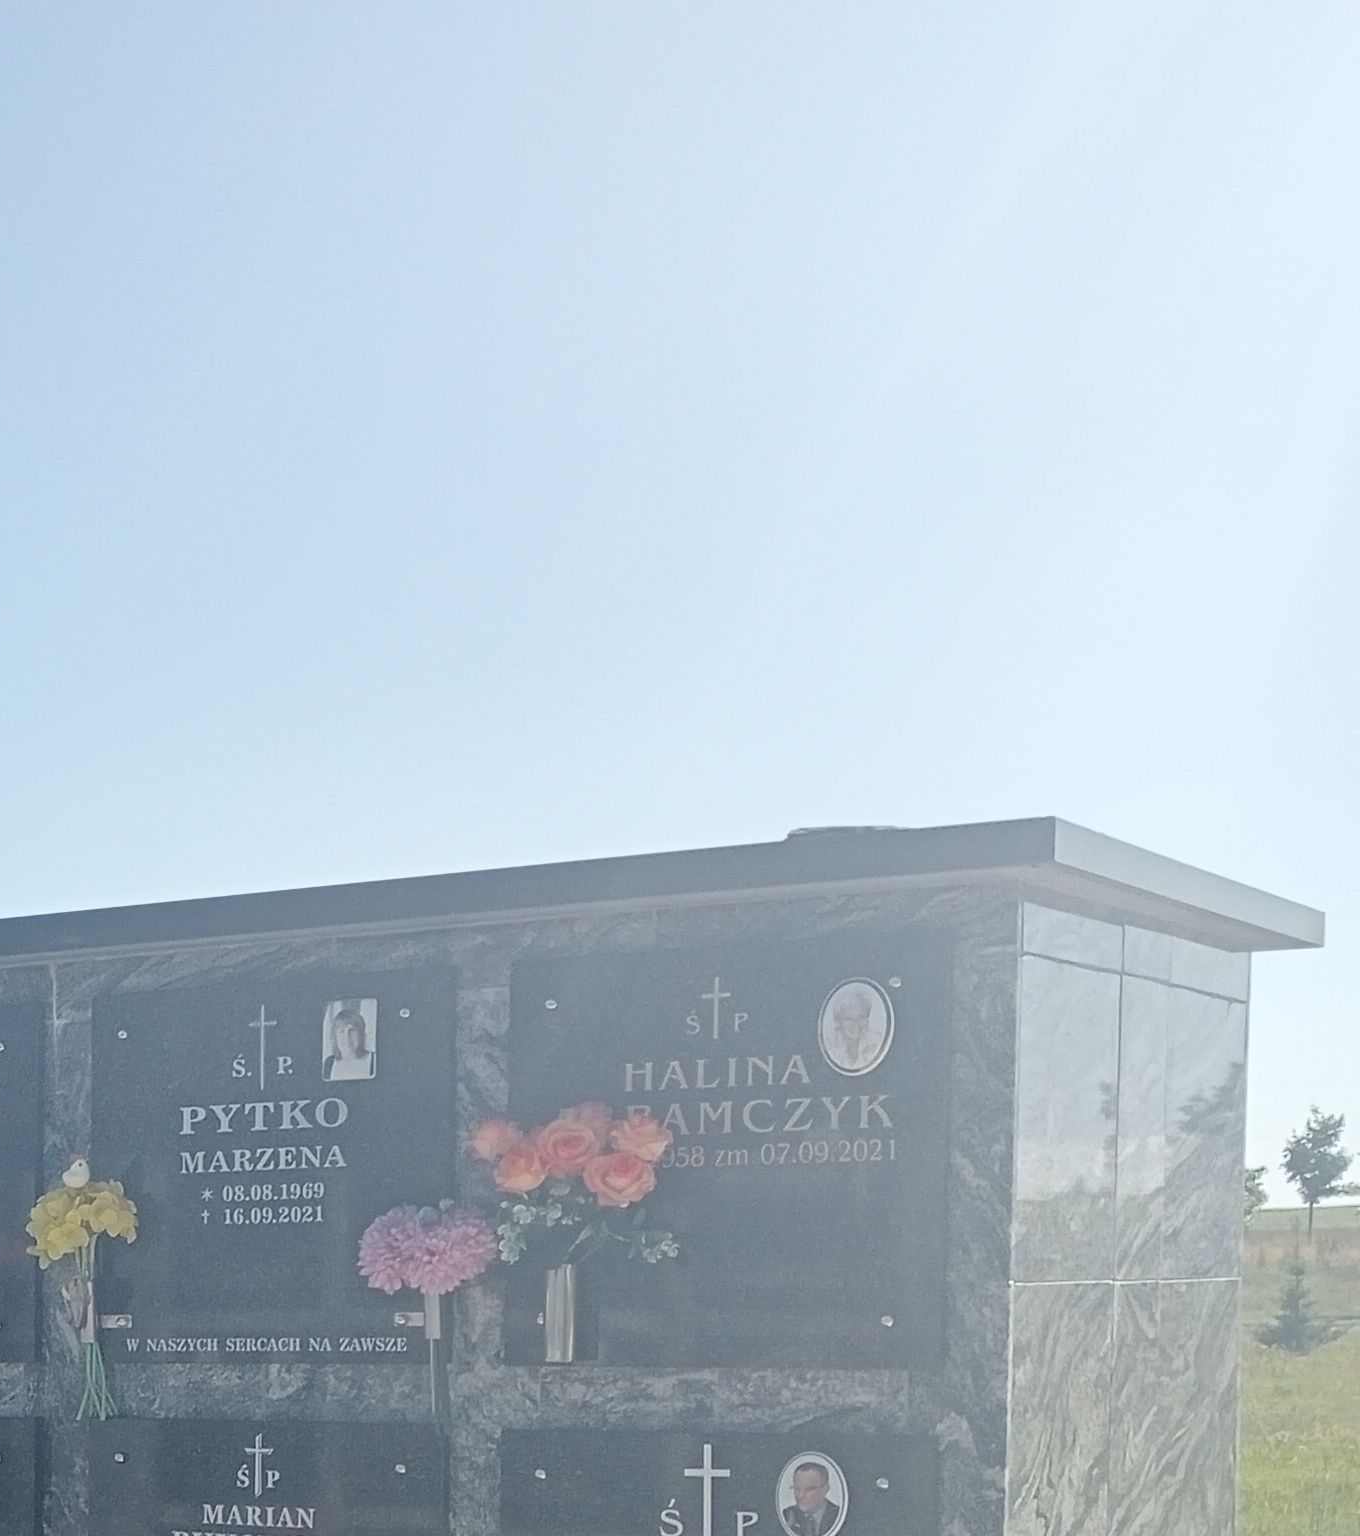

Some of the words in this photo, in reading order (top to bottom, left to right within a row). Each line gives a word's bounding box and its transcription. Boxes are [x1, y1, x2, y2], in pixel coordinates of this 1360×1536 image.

[685, 1009, 701, 1035] Ś
[733, 1012, 749, 1033] P
[624, 1054, 811, 1092] HALINA
[179, 1098, 349, 1135] PYTKO
[180, 1145, 347, 1174] MARZENA
[761, 1139, 897, 1165] 07.09.2021
[222, 1182, 325, 1202] 08.08.1969
[224, 1205, 324, 1225] 16.09.2021
[126, 1337, 140, 1352] W
[146, 1337, 218, 1352] NASZYCH
[225, 1337, 301, 1352] SERCACH
[308, 1337, 332, 1352] NA
[339, 1337, 408, 1353] ZAWSZE
[236, 1464, 250, 1488] Ś
[266, 1470, 280, 1488] P
[202, 1504, 315, 1529] MARIAN
